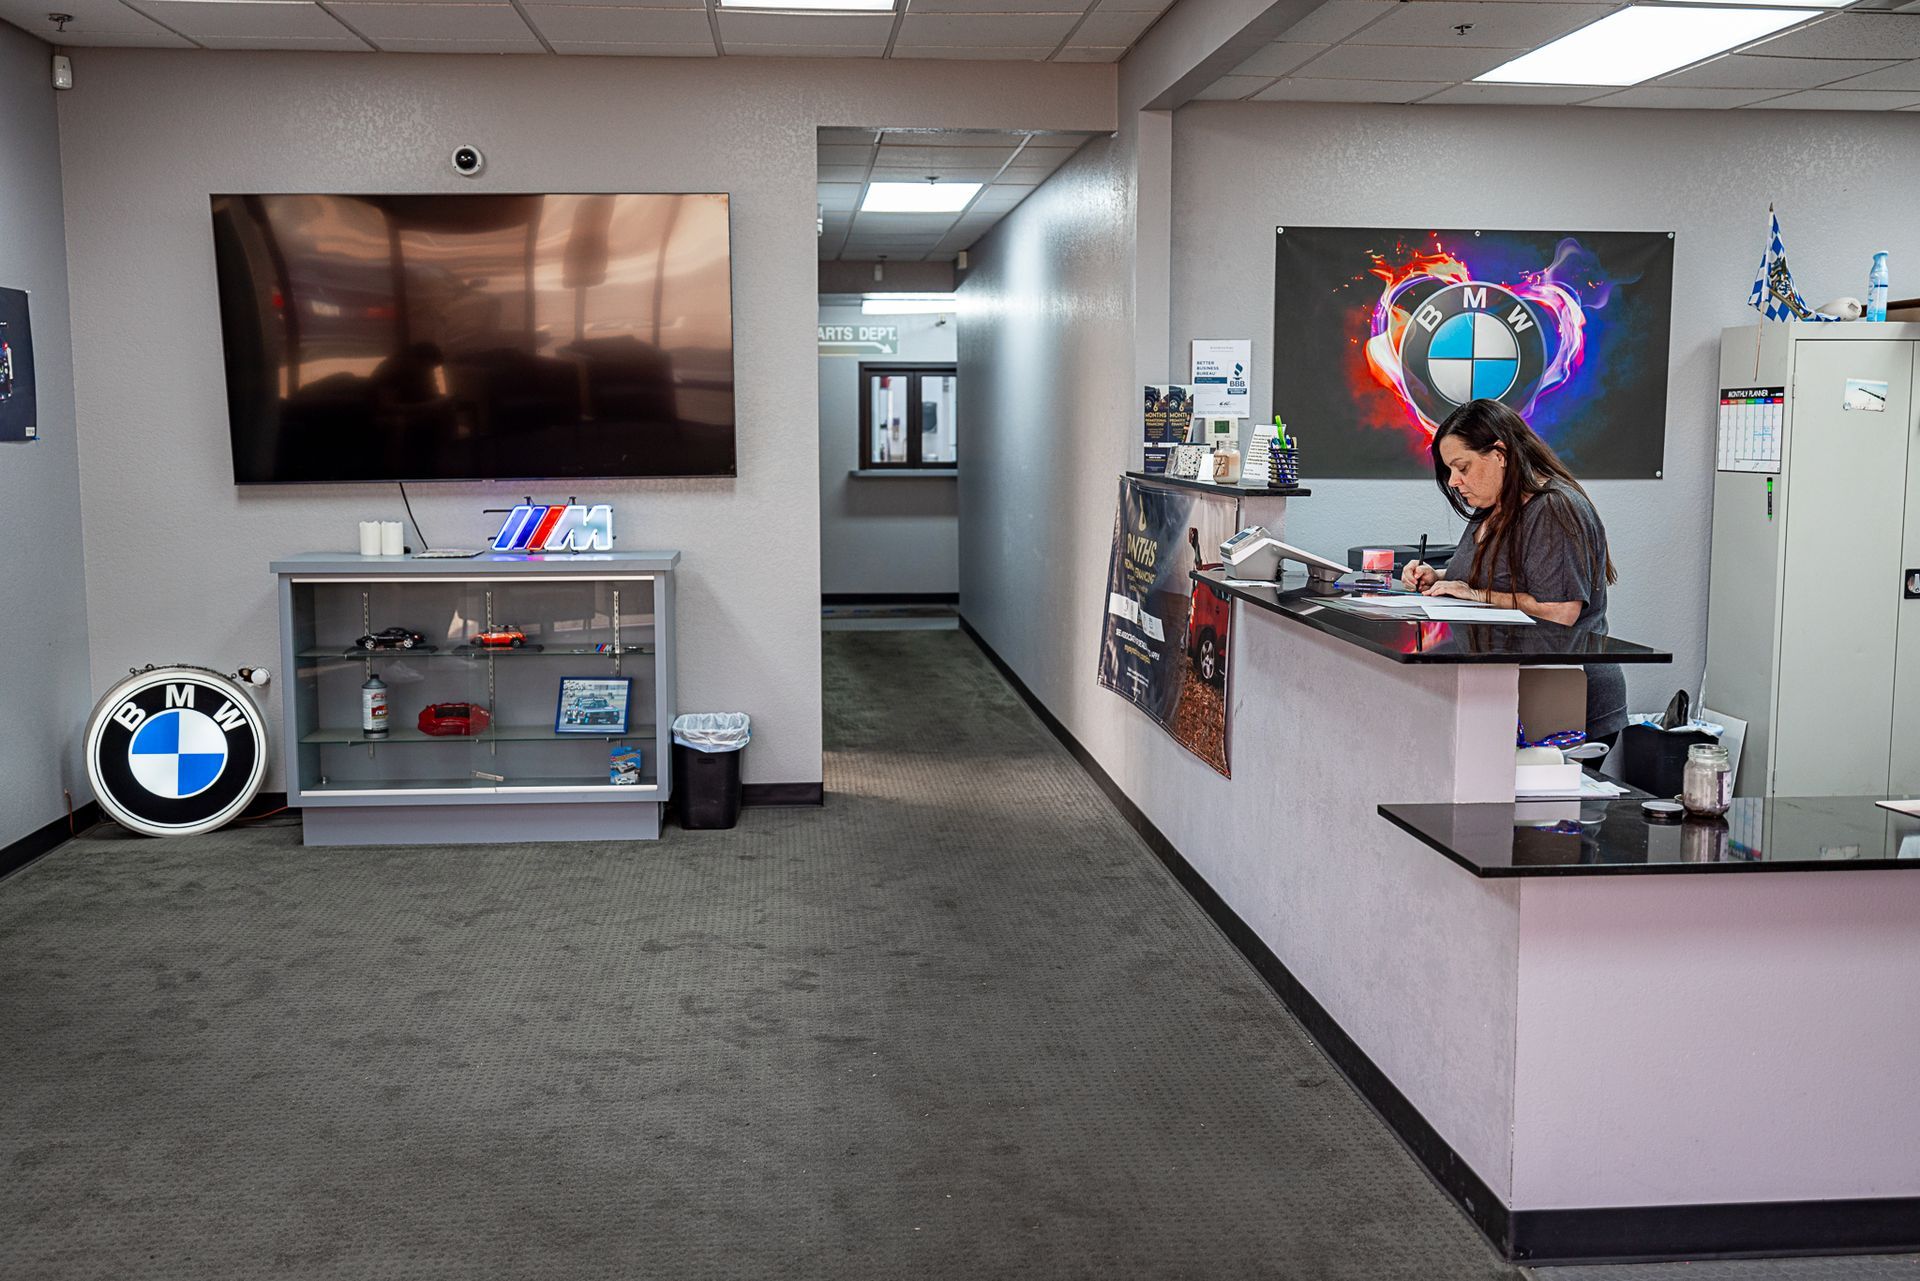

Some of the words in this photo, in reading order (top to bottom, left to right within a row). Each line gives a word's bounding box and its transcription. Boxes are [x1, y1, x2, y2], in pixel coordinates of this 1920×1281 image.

[1415, 287, 1534, 334] BMW
[818, 327, 853, 341] ARTS
[859, 327, 897, 341] DEPT.
[1749, 389, 1769, 398] PLANNER
[1153, 402, 1159, 412] 6
[1179, 402, 1185, 412] 6
[1127, 532, 1158, 568] NTHS
[113, 684, 247, 732] BMW
